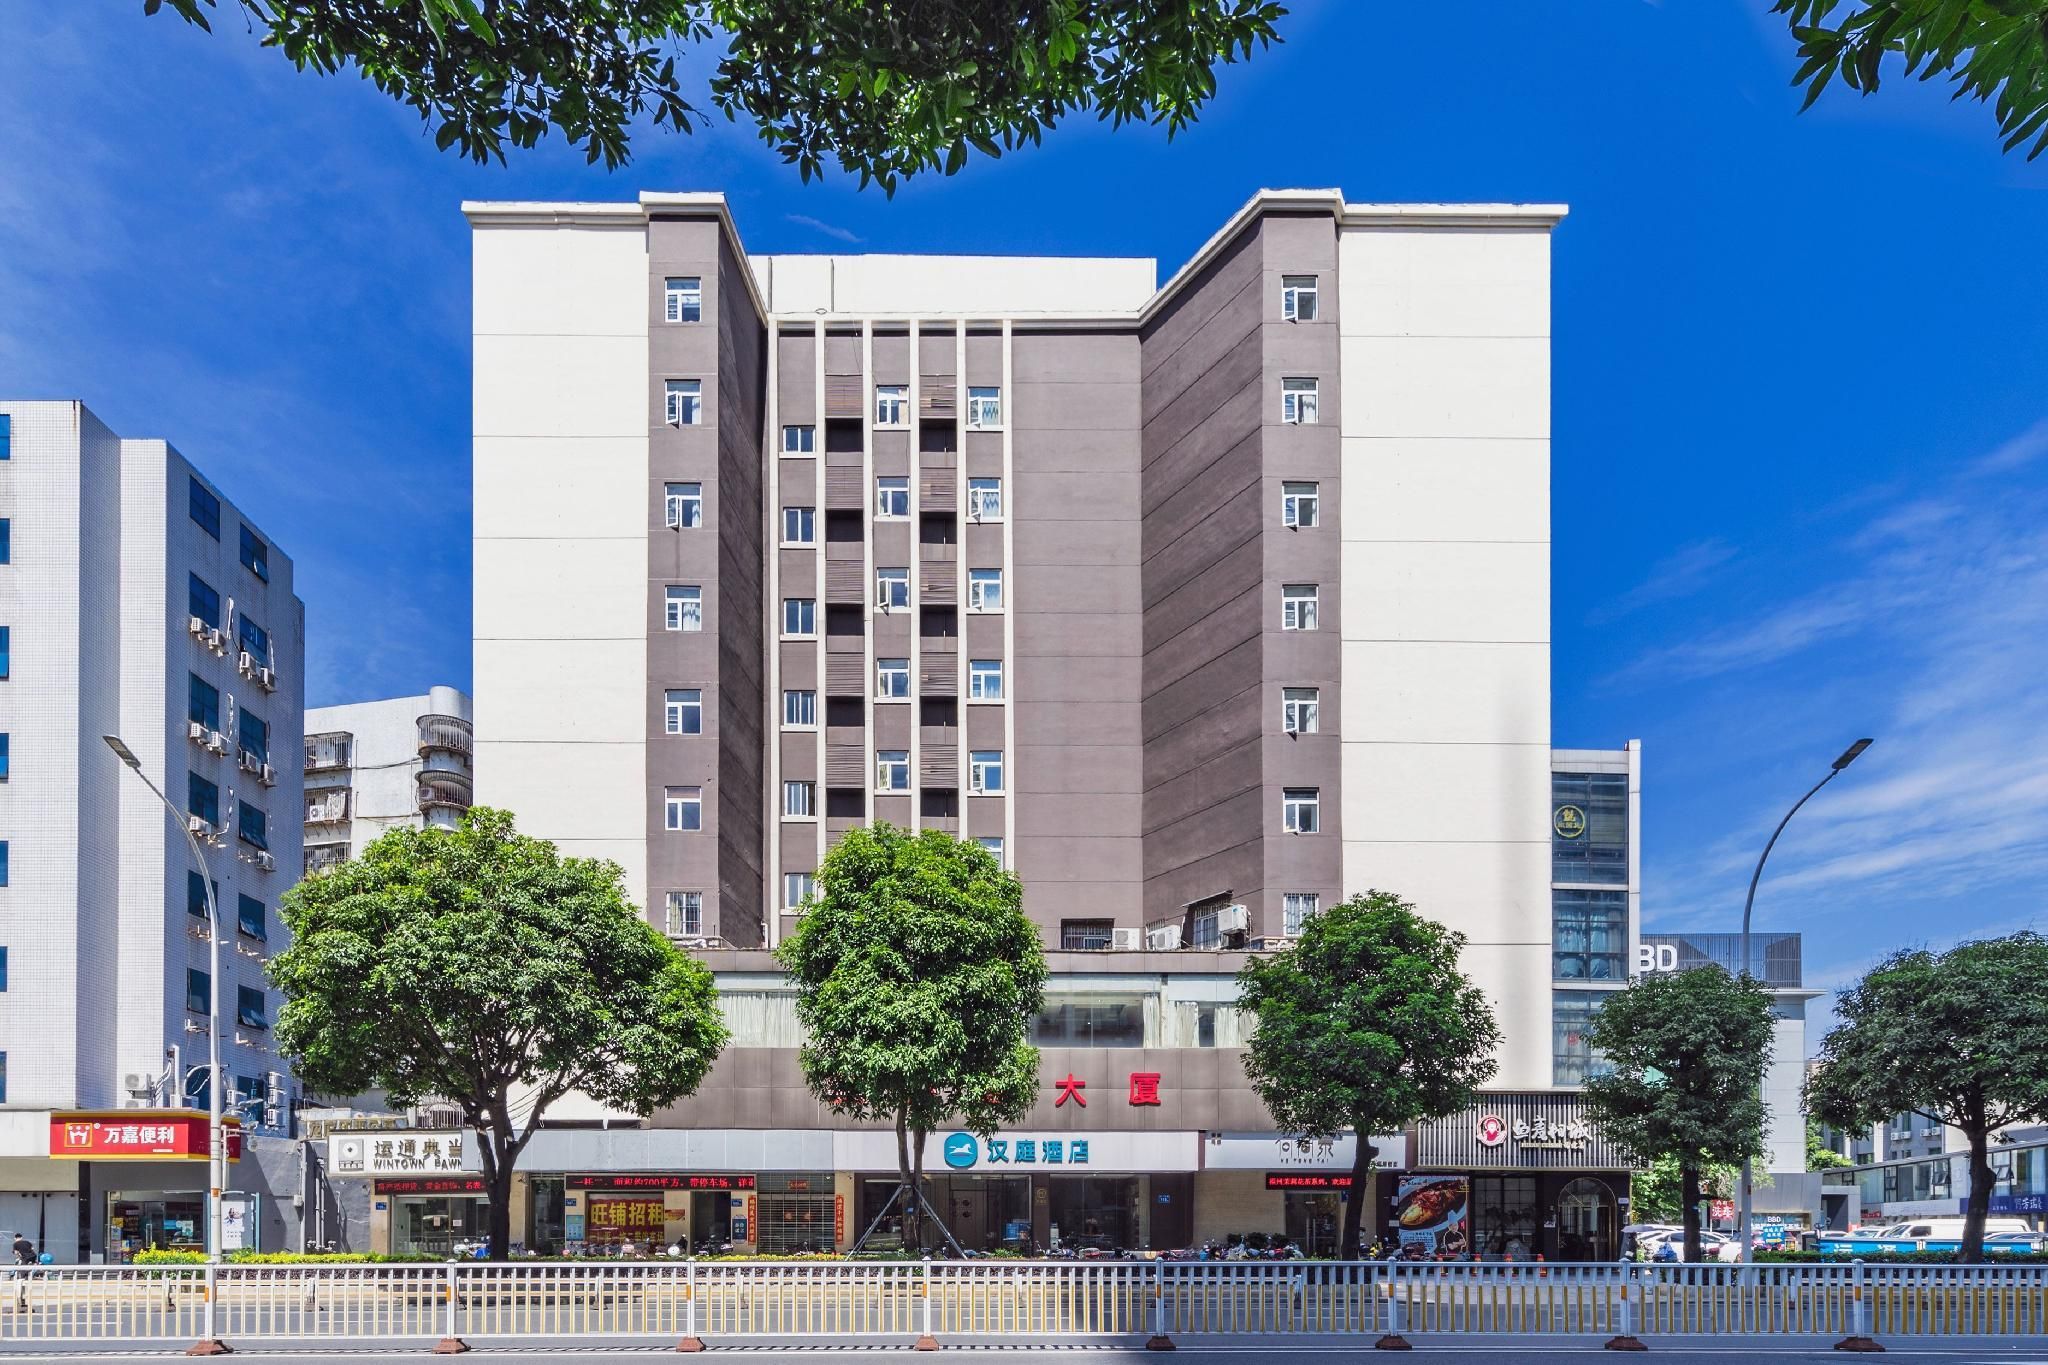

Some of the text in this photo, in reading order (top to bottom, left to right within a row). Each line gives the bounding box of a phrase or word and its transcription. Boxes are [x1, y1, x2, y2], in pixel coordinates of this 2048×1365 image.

[103, 1126, 174, 1144] 万嘉便利
[374, 1138, 462, 1160] 运通典当
[987, 1139, 1089, 1164] 汉庭酒店
[373, 1158, 425, 1170] WINTOWN
[591, 1202, 664, 1226] 旺铺招租
